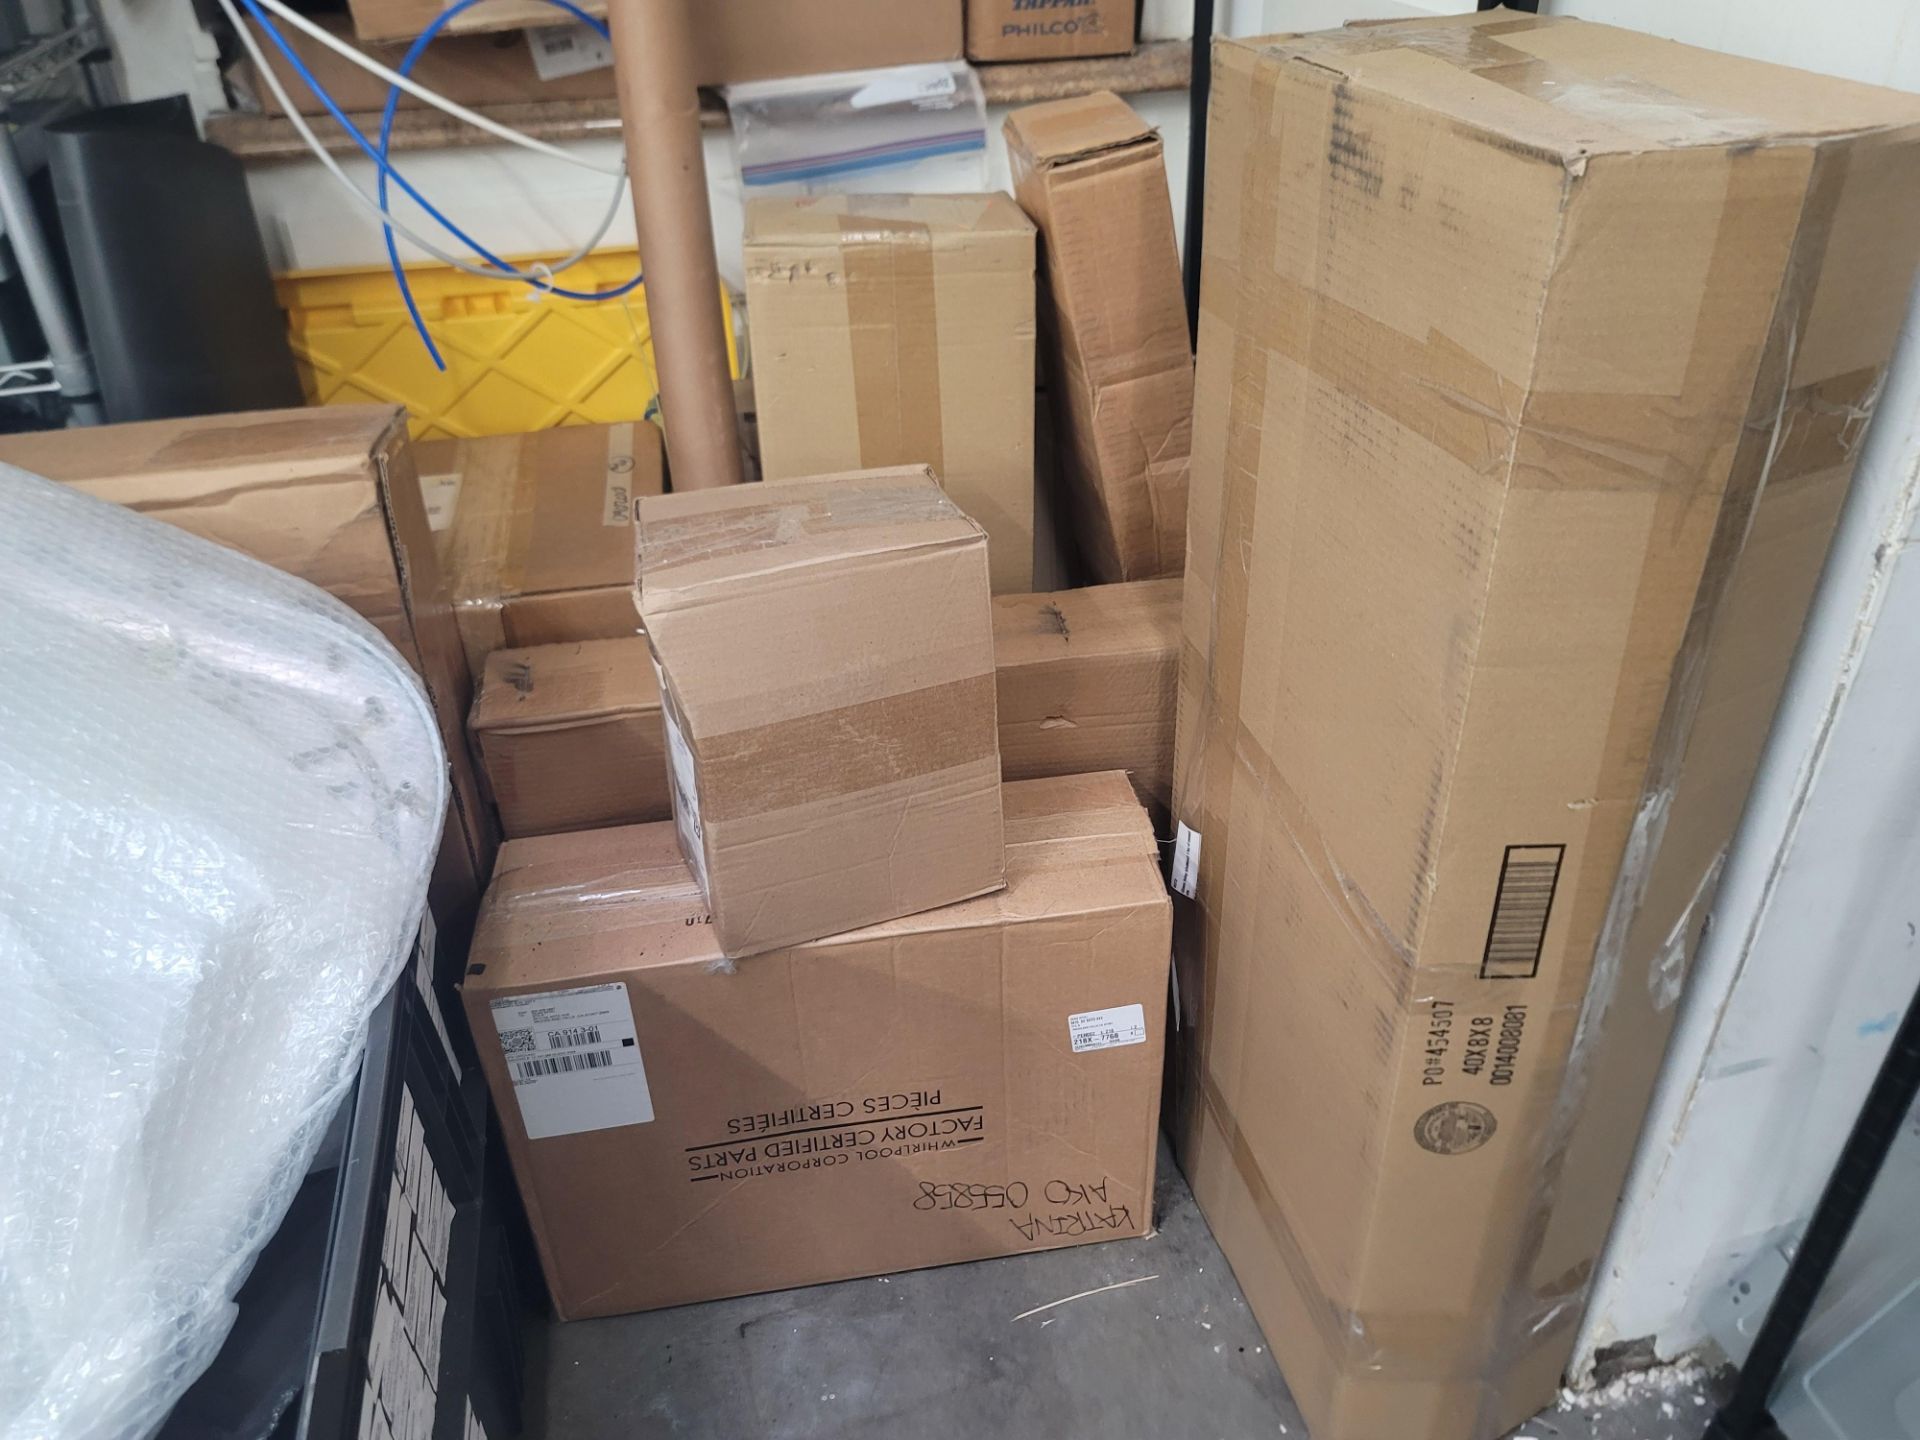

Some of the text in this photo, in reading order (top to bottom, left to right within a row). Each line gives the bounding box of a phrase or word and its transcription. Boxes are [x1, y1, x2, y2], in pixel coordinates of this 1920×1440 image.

[1002, 20, 1079, 37] PHILCO
[548, 1029, 561, 1037] CA
[563, 1028, 578, 1036] 914
[1422, 1001, 1454, 1086] PO#454507
[1462, 1017, 1494, 1076] 40X8X8
[727, 1090, 941, 1134] PIÈCES CERTIFIÉES
[688, 1115, 984, 1171] FACTORY CERTIFIED PARTS
[720, 1139, 955, 1182] WHIRLPOOL CORPORATION
[913, 1181, 1028, 1210] 055858
[1009, 1205, 1135, 1241] KATRINA
